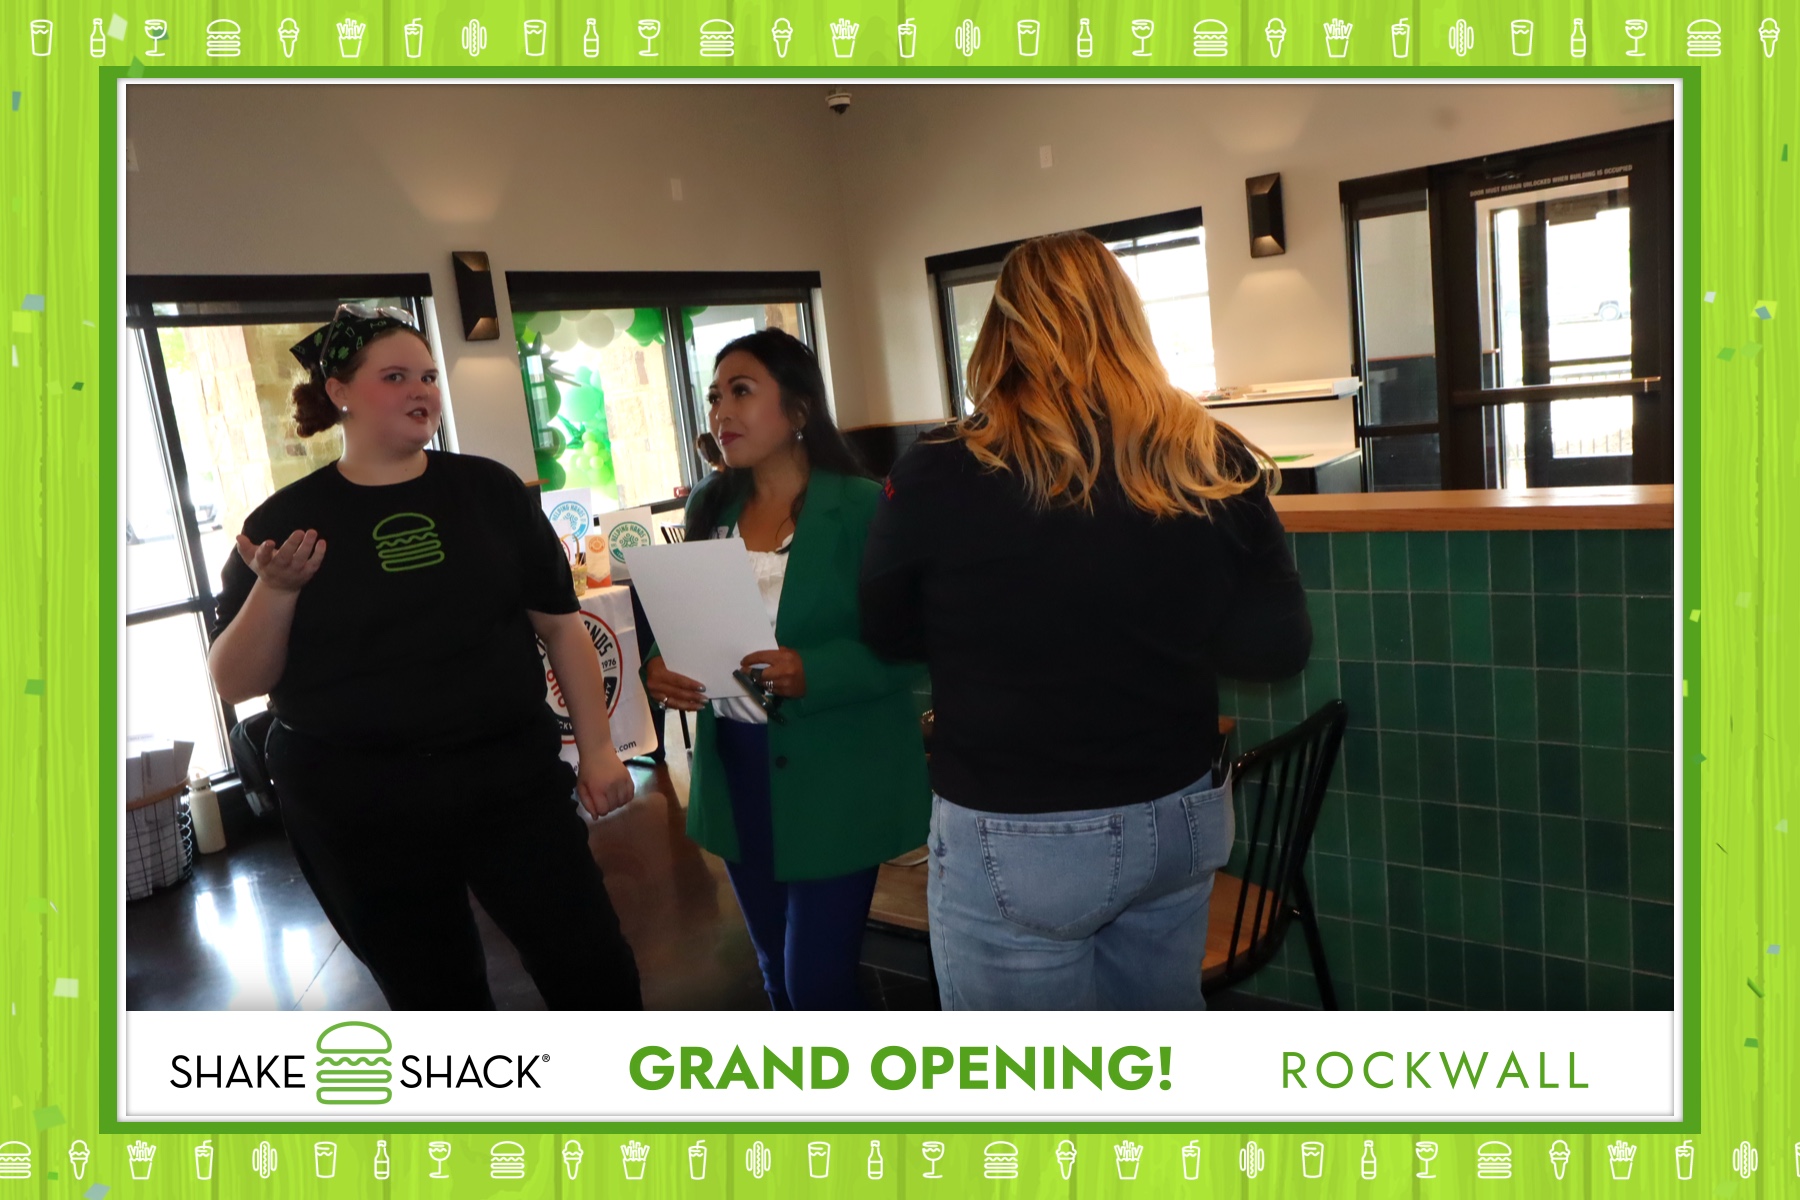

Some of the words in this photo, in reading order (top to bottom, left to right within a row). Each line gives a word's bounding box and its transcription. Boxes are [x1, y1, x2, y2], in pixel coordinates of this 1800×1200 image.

[1485, 186, 1500, 194] MUST
[1501, 182, 1522, 192] REMAIN
[1522, 178, 1551, 188] UNLOCKED
[1552, 175, 1569, 183] WHEN
[1570, 170, 1596, 180] BUILDING
[1597, 168, 1604, 177] IS
[1604, 164, 1633, 175] OCCUPIED
[602, 658, 617, 669] 1976
